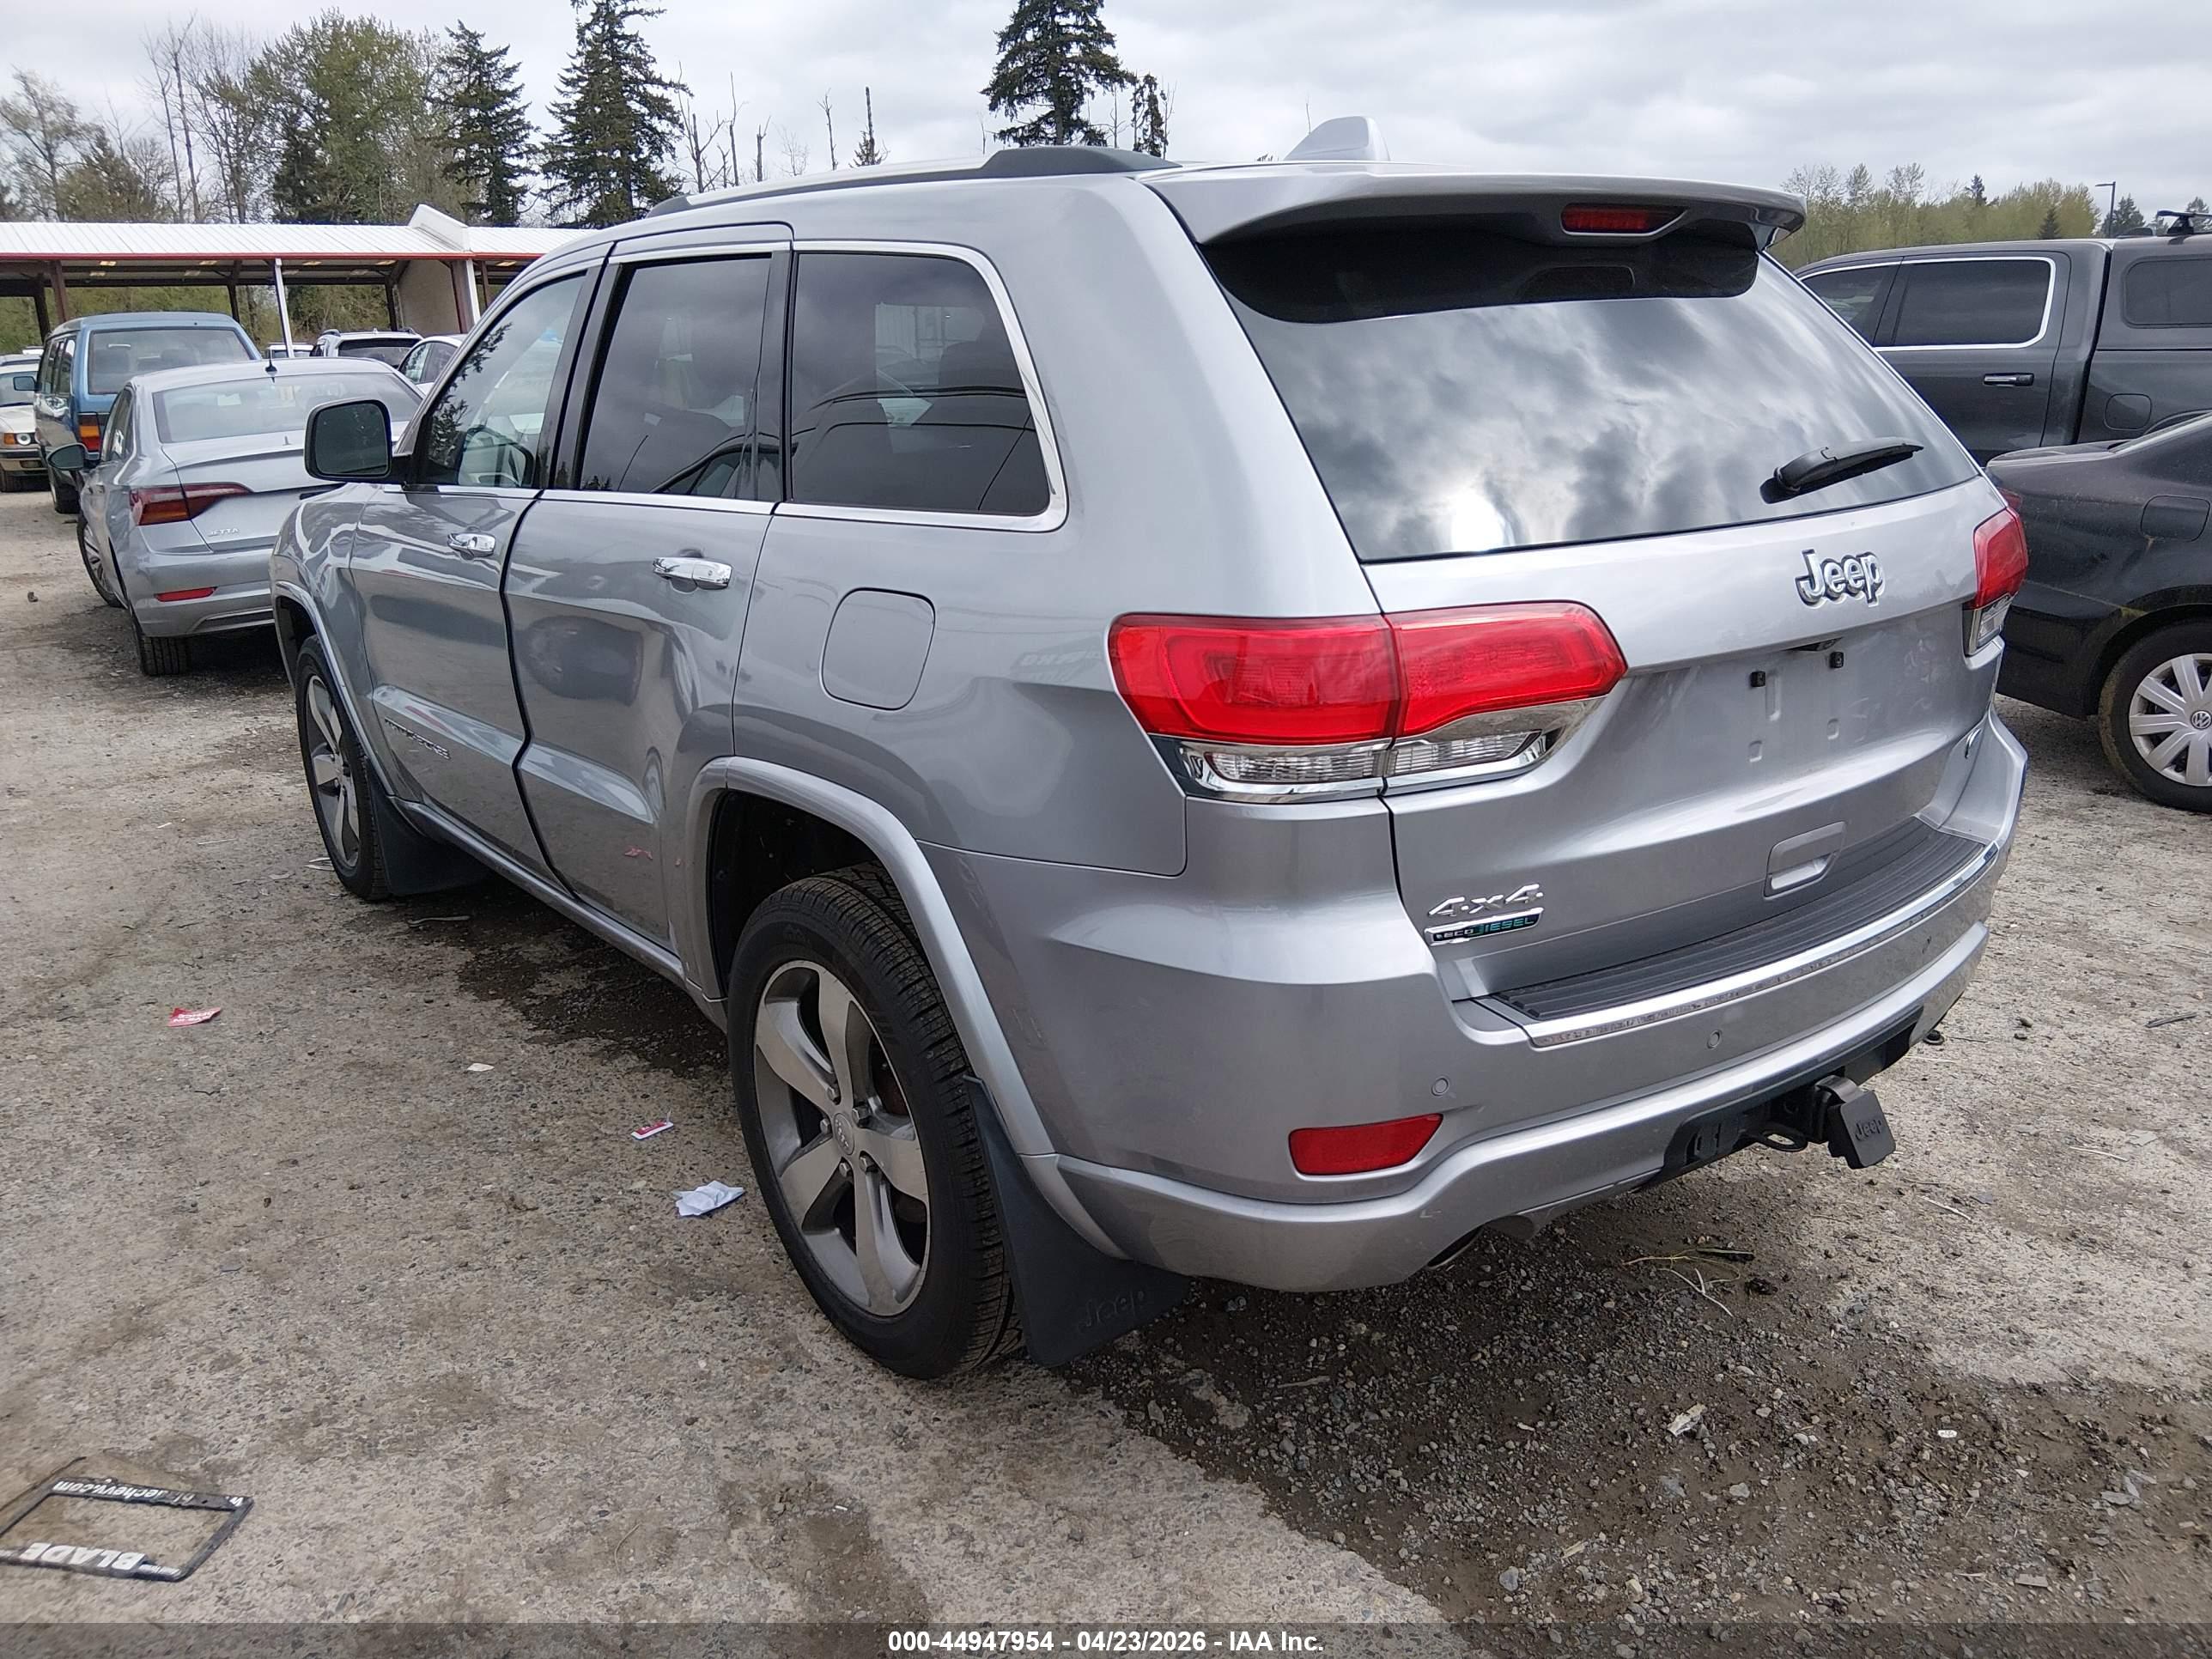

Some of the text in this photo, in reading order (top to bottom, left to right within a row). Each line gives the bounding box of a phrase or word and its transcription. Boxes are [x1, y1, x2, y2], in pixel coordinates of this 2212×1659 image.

[1795, 549, 1884, 607] Jeep
[1855, 1119, 1881, 1141] Jeep
[19, 1542, 146, 1570] BLADE
